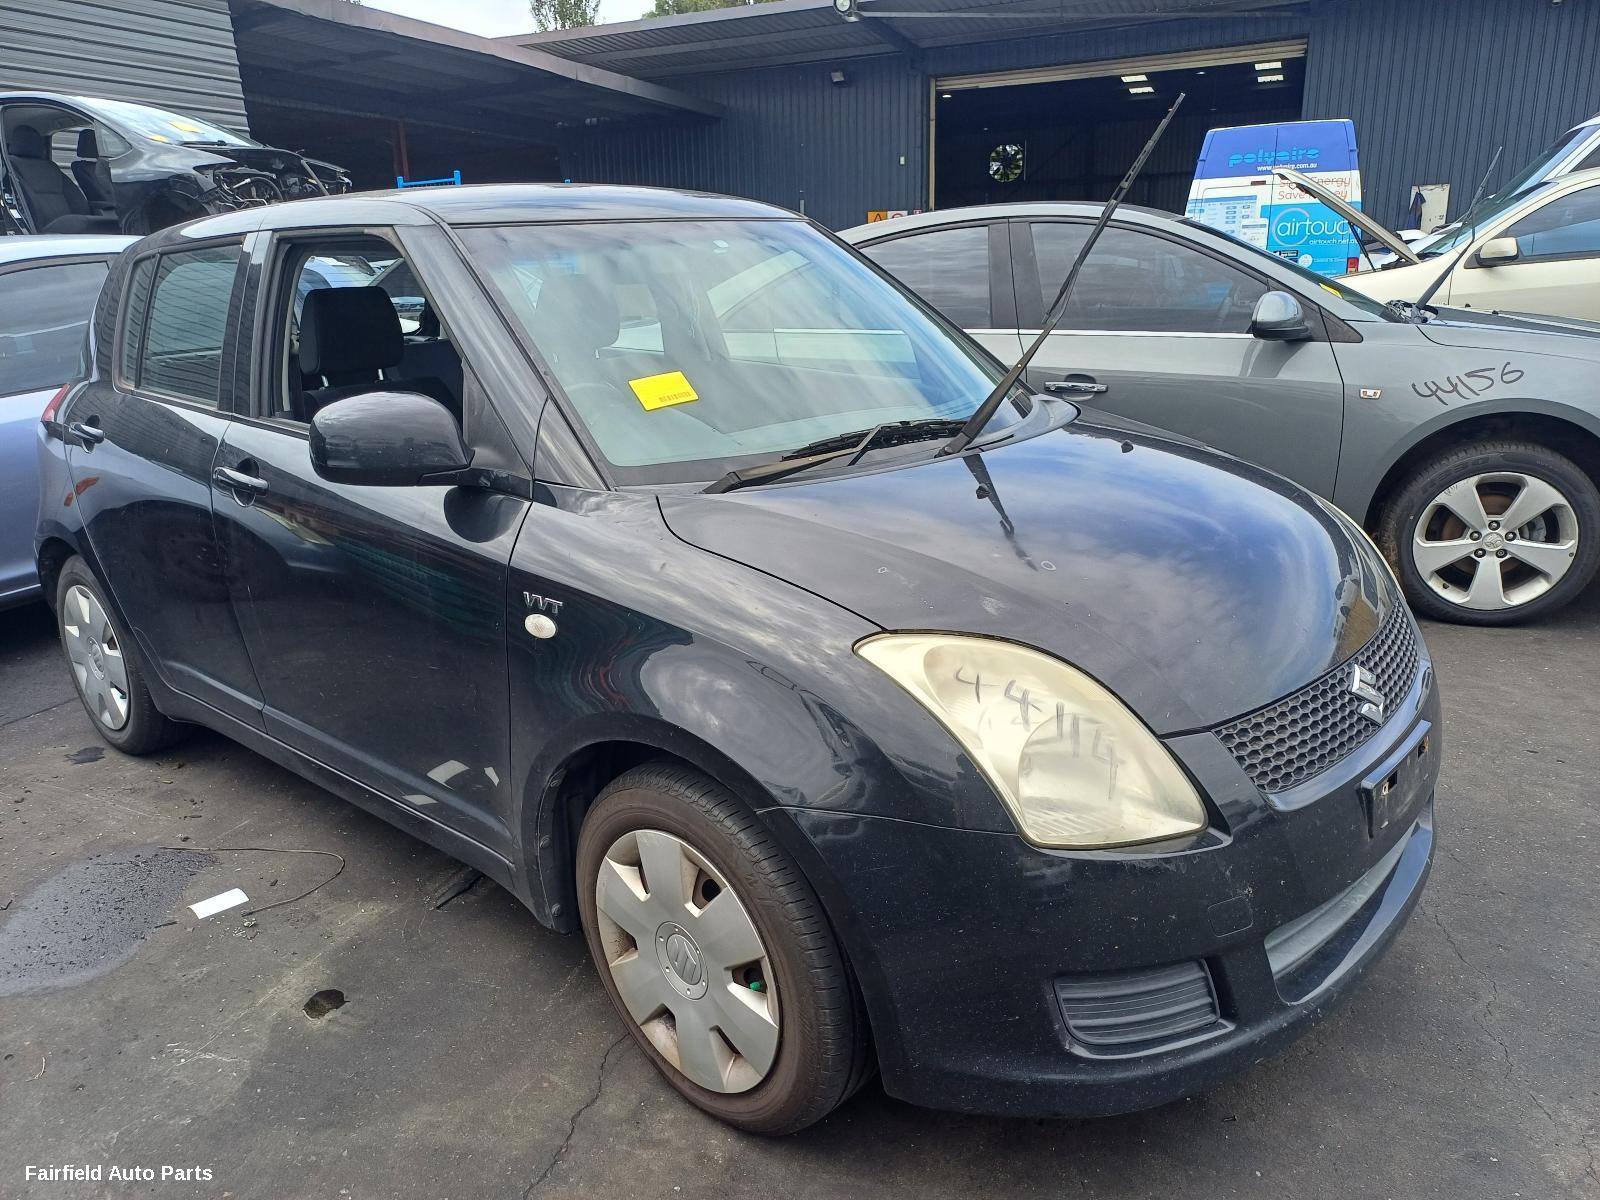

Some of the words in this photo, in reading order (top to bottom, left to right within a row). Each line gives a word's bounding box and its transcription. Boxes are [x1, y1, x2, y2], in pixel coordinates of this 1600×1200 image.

[1229, 147, 1319, 167] polyaire
[1277, 218, 1349, 236] airtouc
[1411, 361, 1524, 406] 44156
[523, 591, 563, 614] VVT
